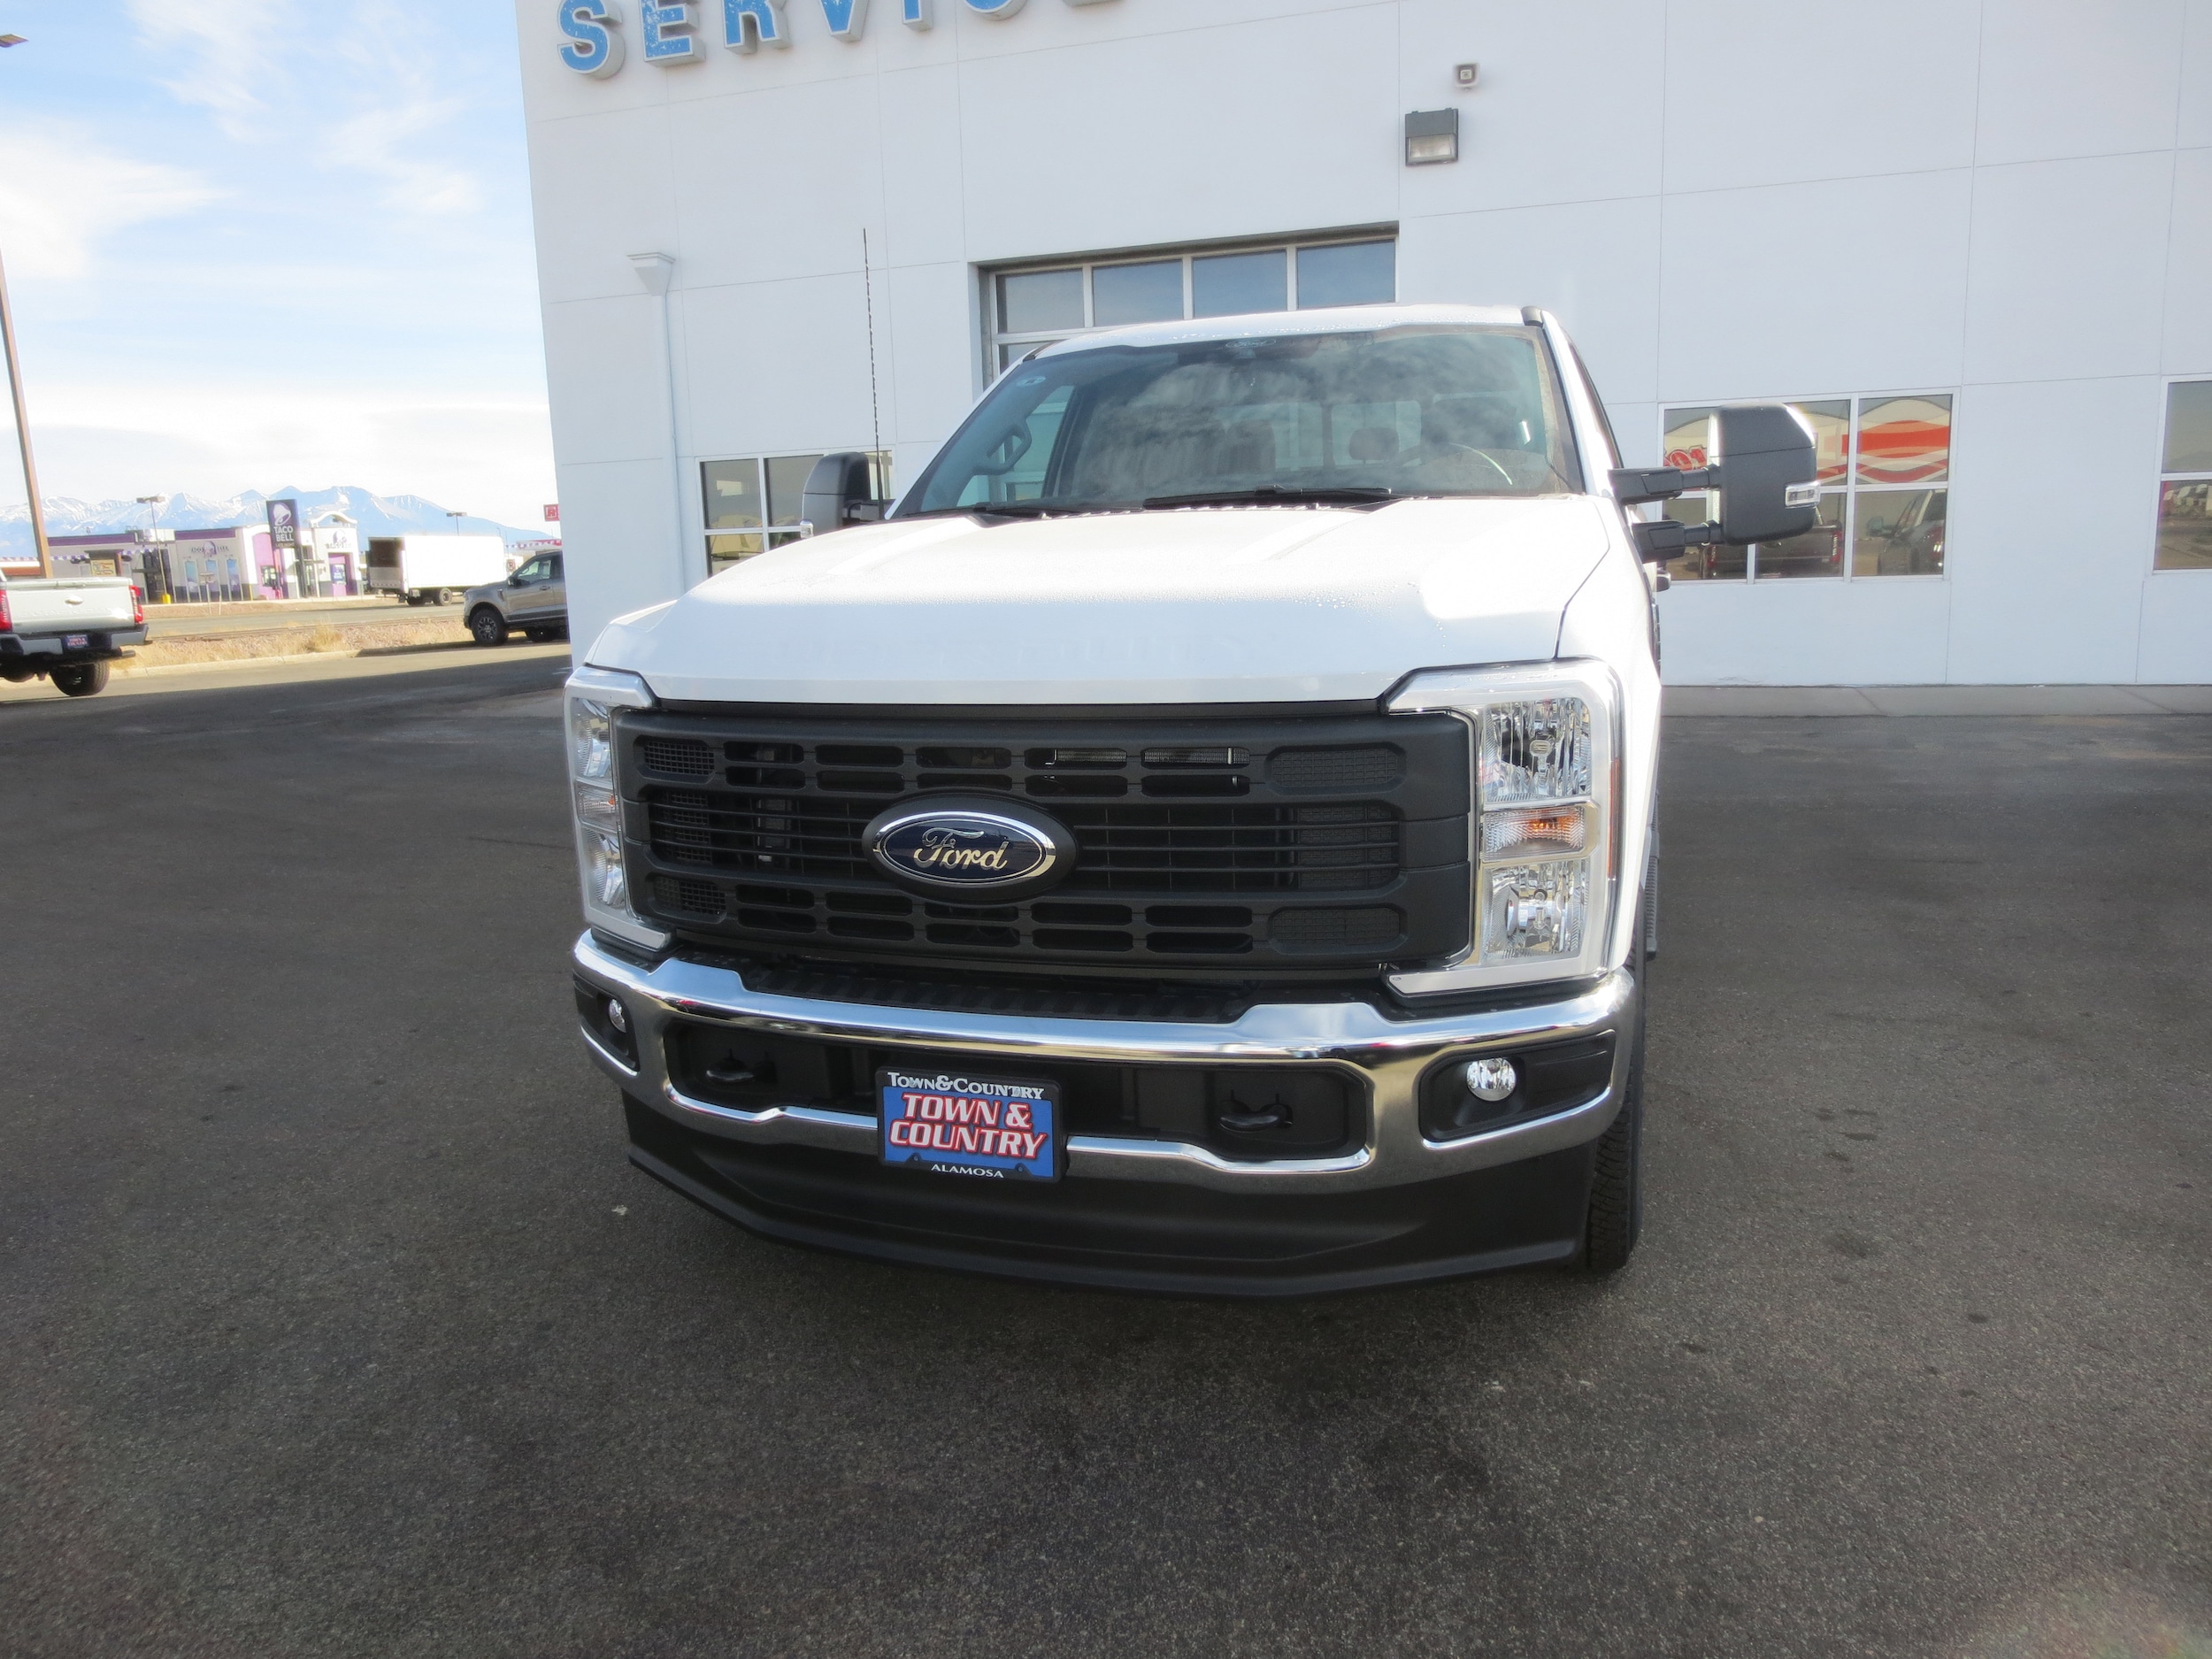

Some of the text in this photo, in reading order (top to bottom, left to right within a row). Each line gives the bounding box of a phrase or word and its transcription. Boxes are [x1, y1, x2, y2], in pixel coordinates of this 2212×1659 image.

[914, 827, 1009, 871] Ford
[902, 1091, 1032, 1130] TOWN &
[890, 1119, 1048, 1159] COUNTRY
[931, 1164, 1004, 1179] ALAMOSA
